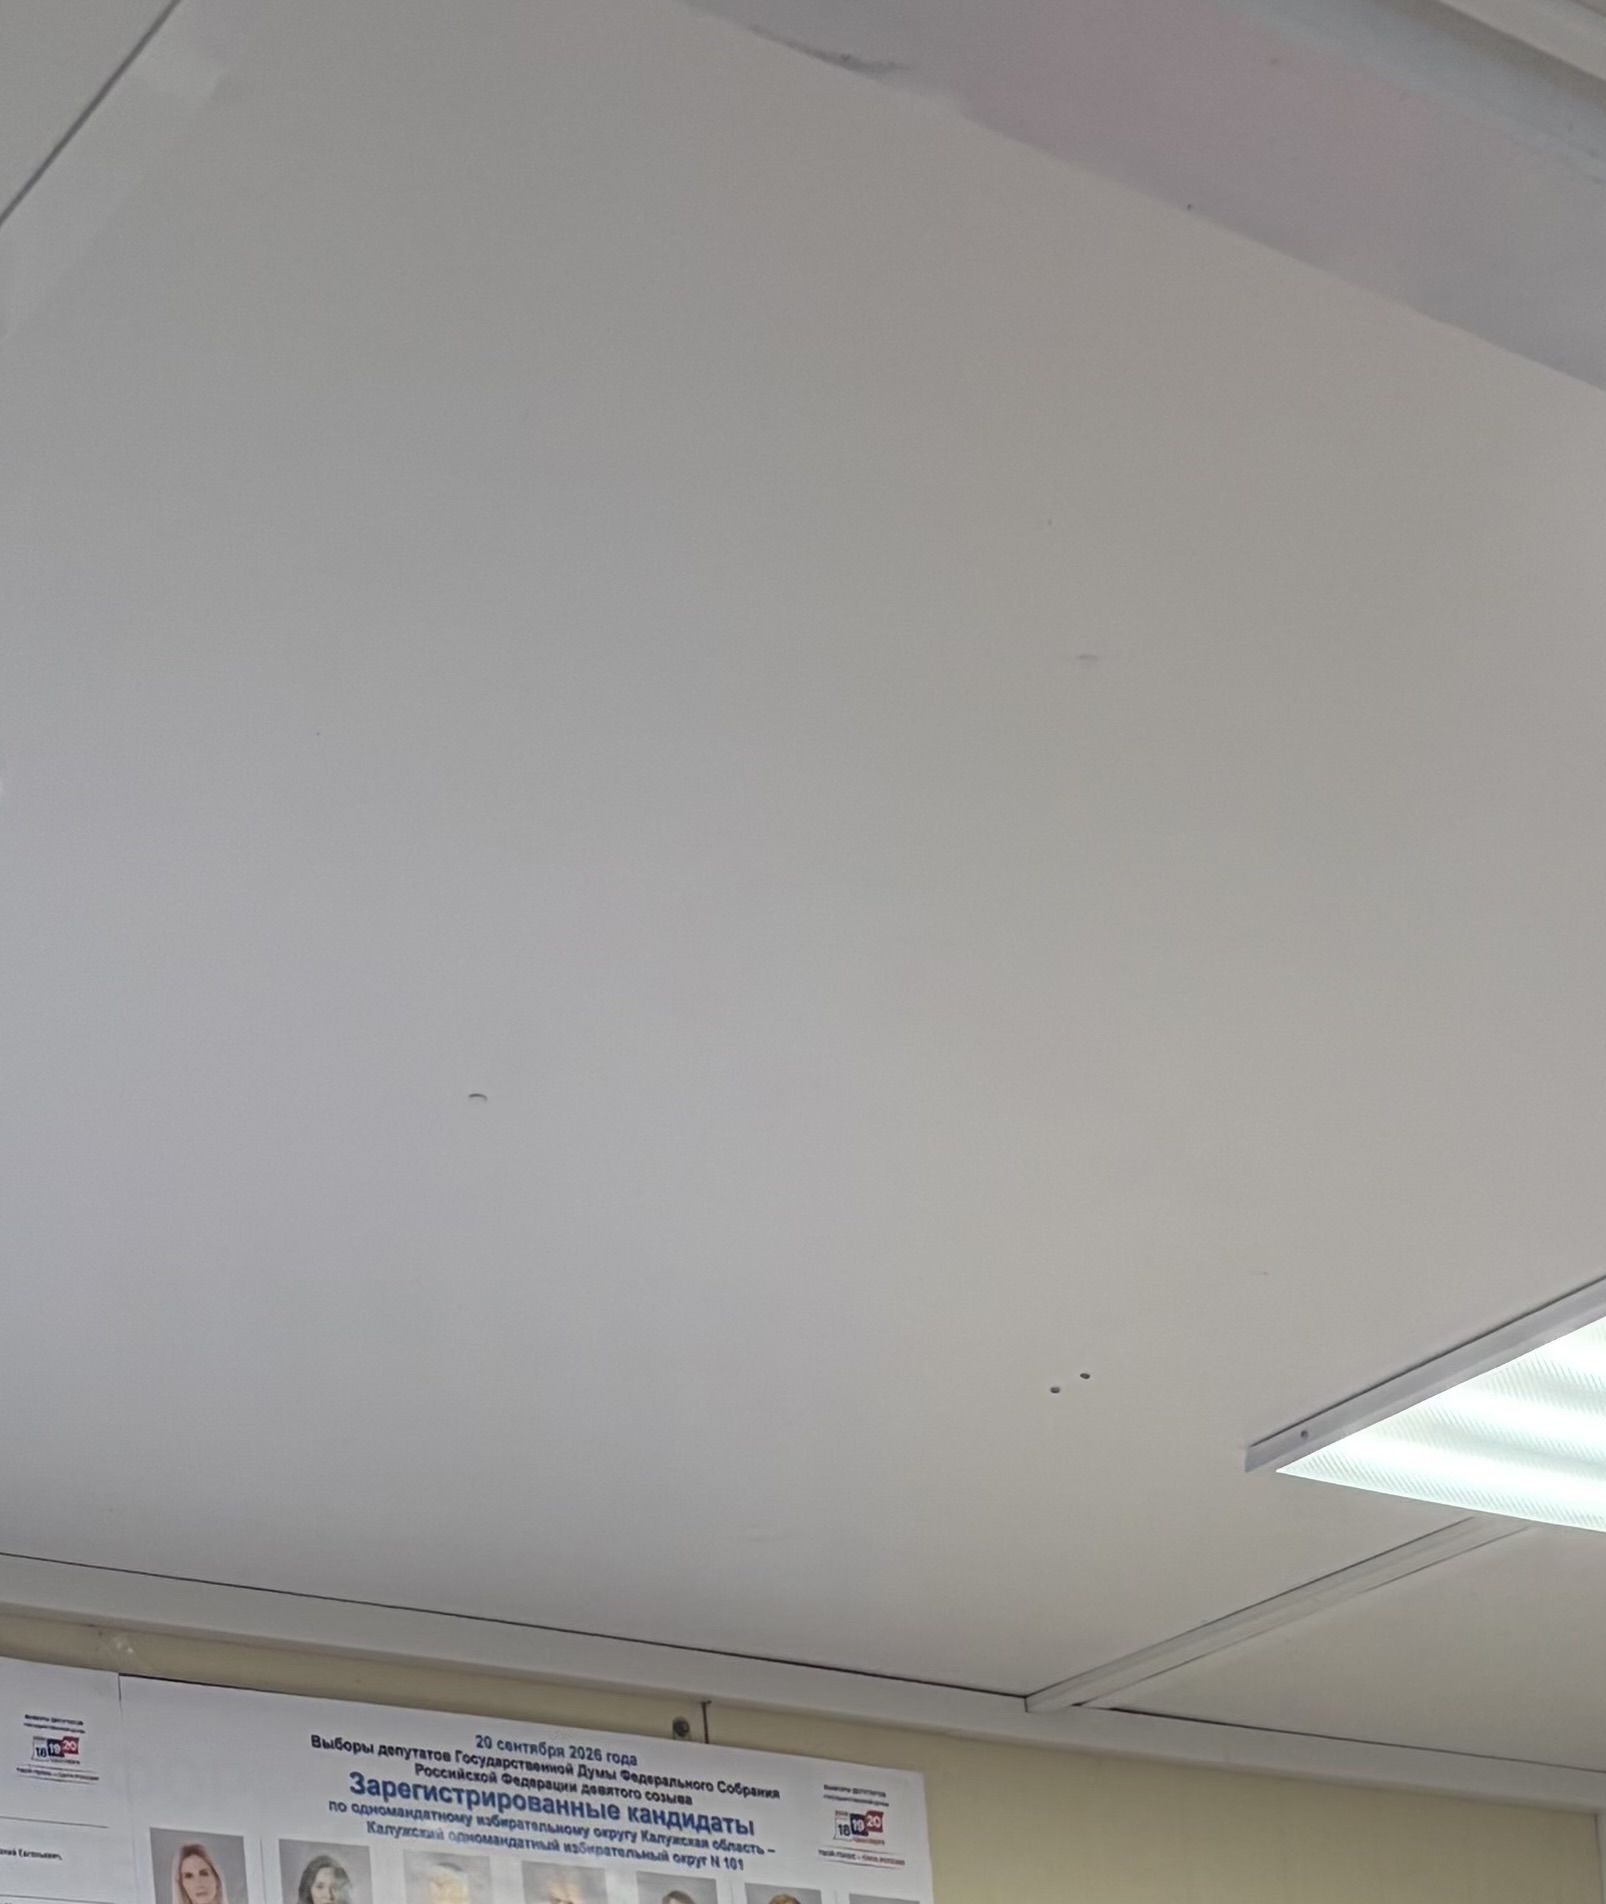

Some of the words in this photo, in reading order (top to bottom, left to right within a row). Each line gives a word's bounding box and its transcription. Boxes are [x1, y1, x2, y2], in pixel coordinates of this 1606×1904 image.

[62, 1739, 77, 1750] 20
[310, 1734, 374, 1756] Выборы
[378, 1744, 451, 1763] депутатов
[455, 1749, 574, 1776] Государственной
[577, 1764, 617, 1781] Думы
[620, 1769, 714, 1793] Федерального
[717, 1780, 781, 1800] Собрания
[475, 1734, 492, 1749] 20
[497, 1739, 565, 1759] сентября
[569, 1744, 602, 1762] 2026
[606, 1752, 638, 1767] года
[349, 1771, 621, 1822] Зарегистрированные
[627, 1804, 755, 1837] кандидаты
[415, 1763, 498, 1784] Российской
[501, 1773, 577, 1794] Федерации
[581, 1783, 642, 1801] девятого
[645, 1790, 693, 1806] созыва
[329, 1799, 348, 1813] по
[351, 1803, 473, 1828] одномандатному
[476, 1813, 590, 1840] избирательному
[593, 1827, 637, 1844] округу
[641, 1830, 709, 1850] Калужская
[712, 1838, 765, 1856] область
[866, 1814, 881, 1828] 20
[367, 1820, 444, 1841] Калужский
[448, 1832, 560, 1852] одномандатный
[564, 1842, 669, 1862] избирательный
[673, 1853, 707, 1868] округ
[710, 1855, 721, 1868] N
[723, 1856, 744, 1871] 101
